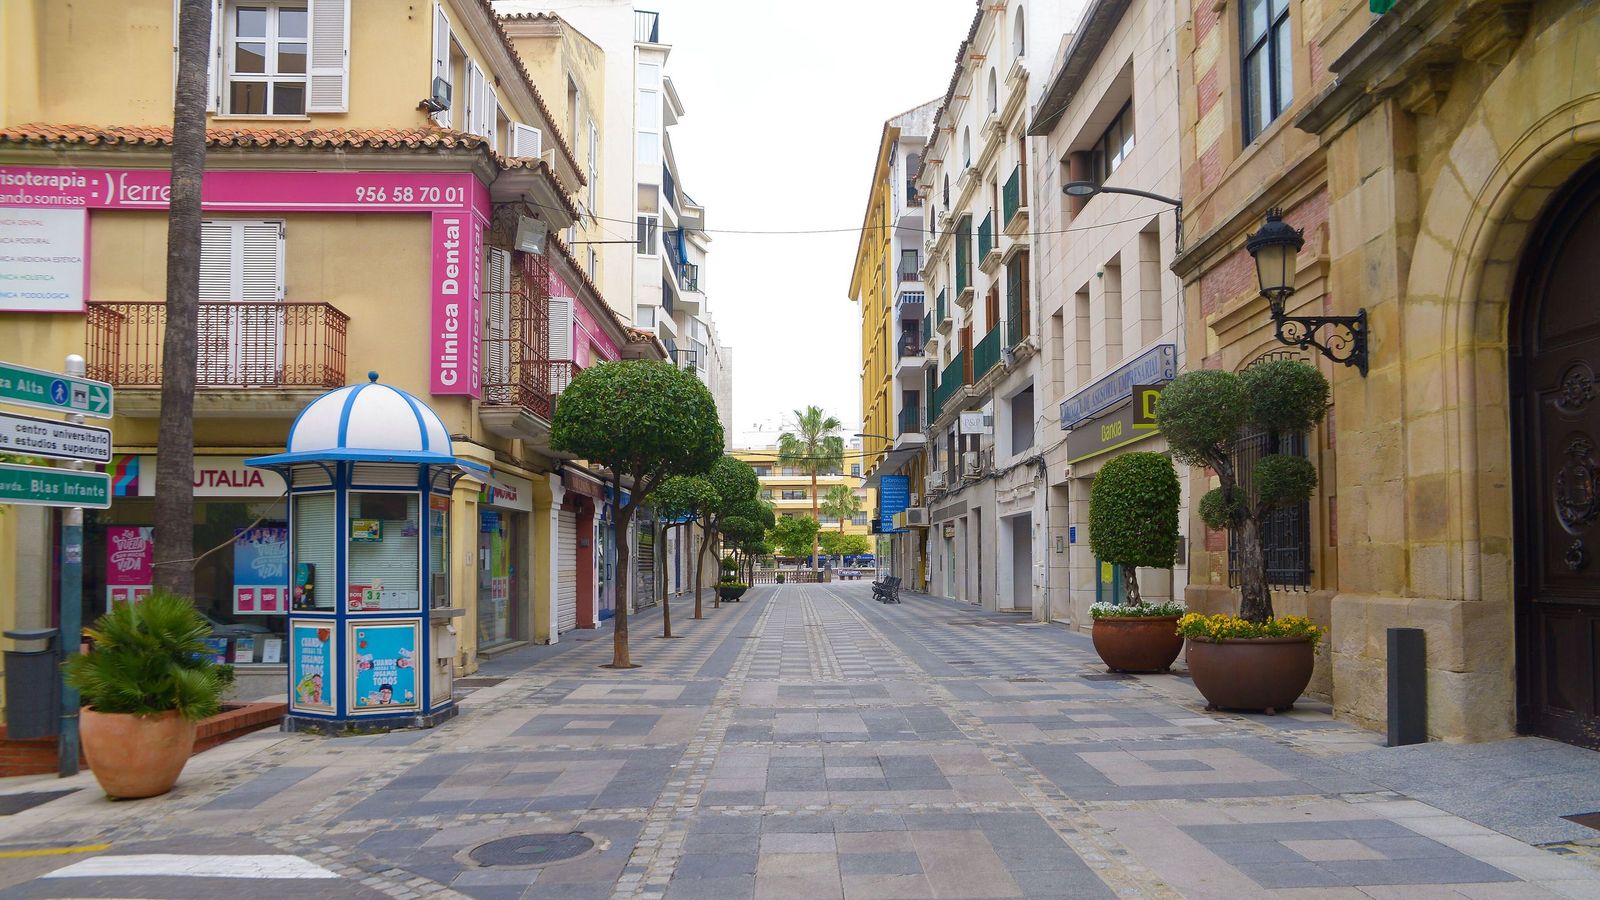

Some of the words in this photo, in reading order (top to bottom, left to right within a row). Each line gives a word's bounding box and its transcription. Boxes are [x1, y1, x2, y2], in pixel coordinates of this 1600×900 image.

[0, 170, 86, 191] isoterapia
[34, 192, 86, 205] sonrisas
[355, 186, 386, 202] 956
[392, 186, 413, 202] 58
[419, 186, 441, 202] 70
[445, 186, 464, 202] 01
[442, 218, 460, 295] Dental
[440, 303, 459, 386] Clinica
[1163, 346, 1172, 357] C
[1164, 369, 1173, 379] G
[16, 378, 44, 395] Alta
[15, 424, 48, 436] centro
[53, 430, 107, 444] universitario
[15, 437, 57, 450] estudios
[62, 443, 107, 455] superiores
[31, 479, 59, 493] Blas
[64, 482, 105, 496] Infante
